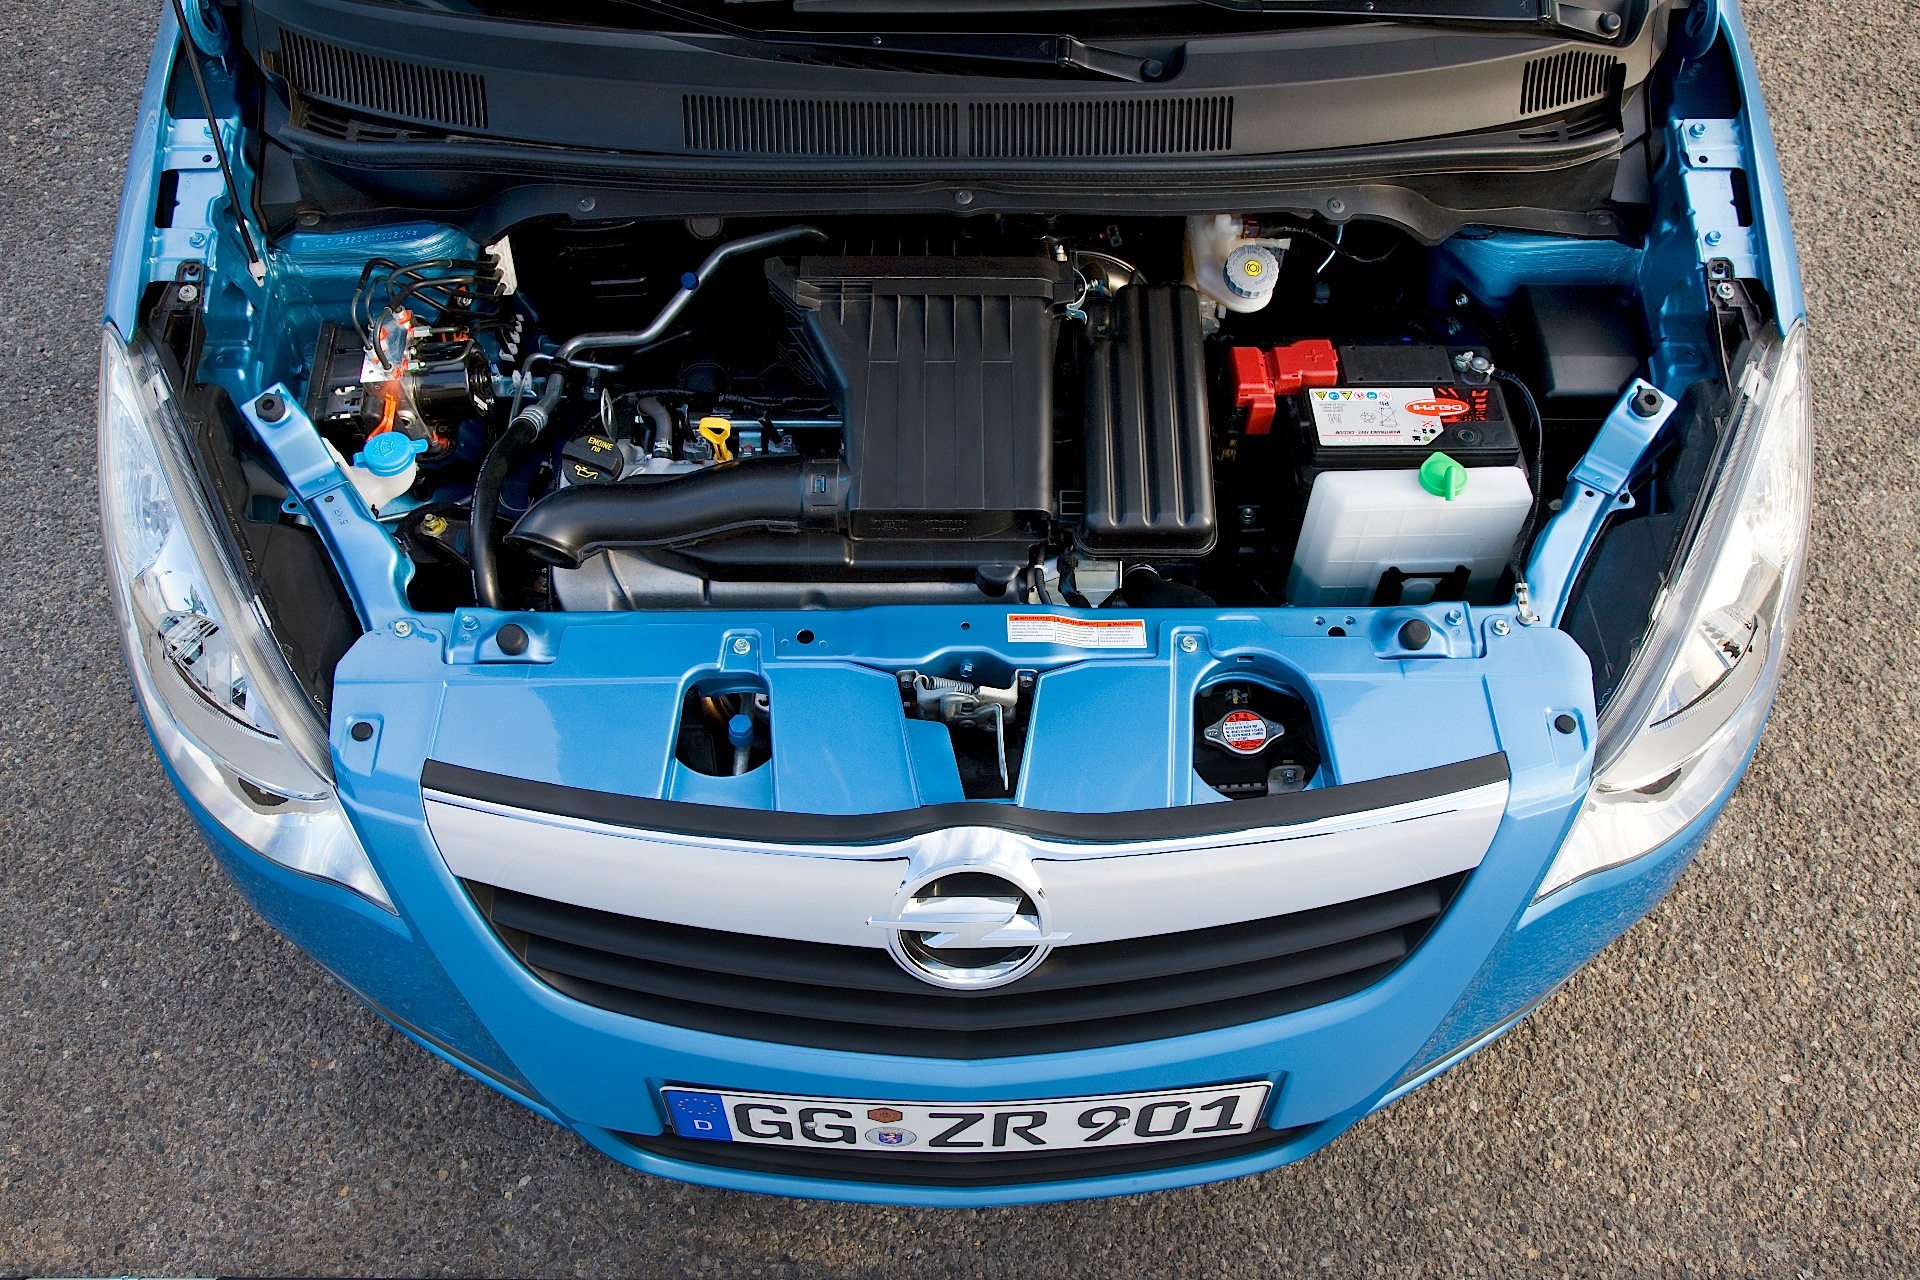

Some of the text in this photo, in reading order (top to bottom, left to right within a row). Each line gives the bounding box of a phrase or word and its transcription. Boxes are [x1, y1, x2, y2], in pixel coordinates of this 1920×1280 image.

[588, 436, 614, 451] ENGINE
[694, 1119, 713, 1131] D
[733, 1103, 857, 1145] GG
[928, 1110, 1048, 1148] ZR
[1077, 1095, 1244, 1143] 901
